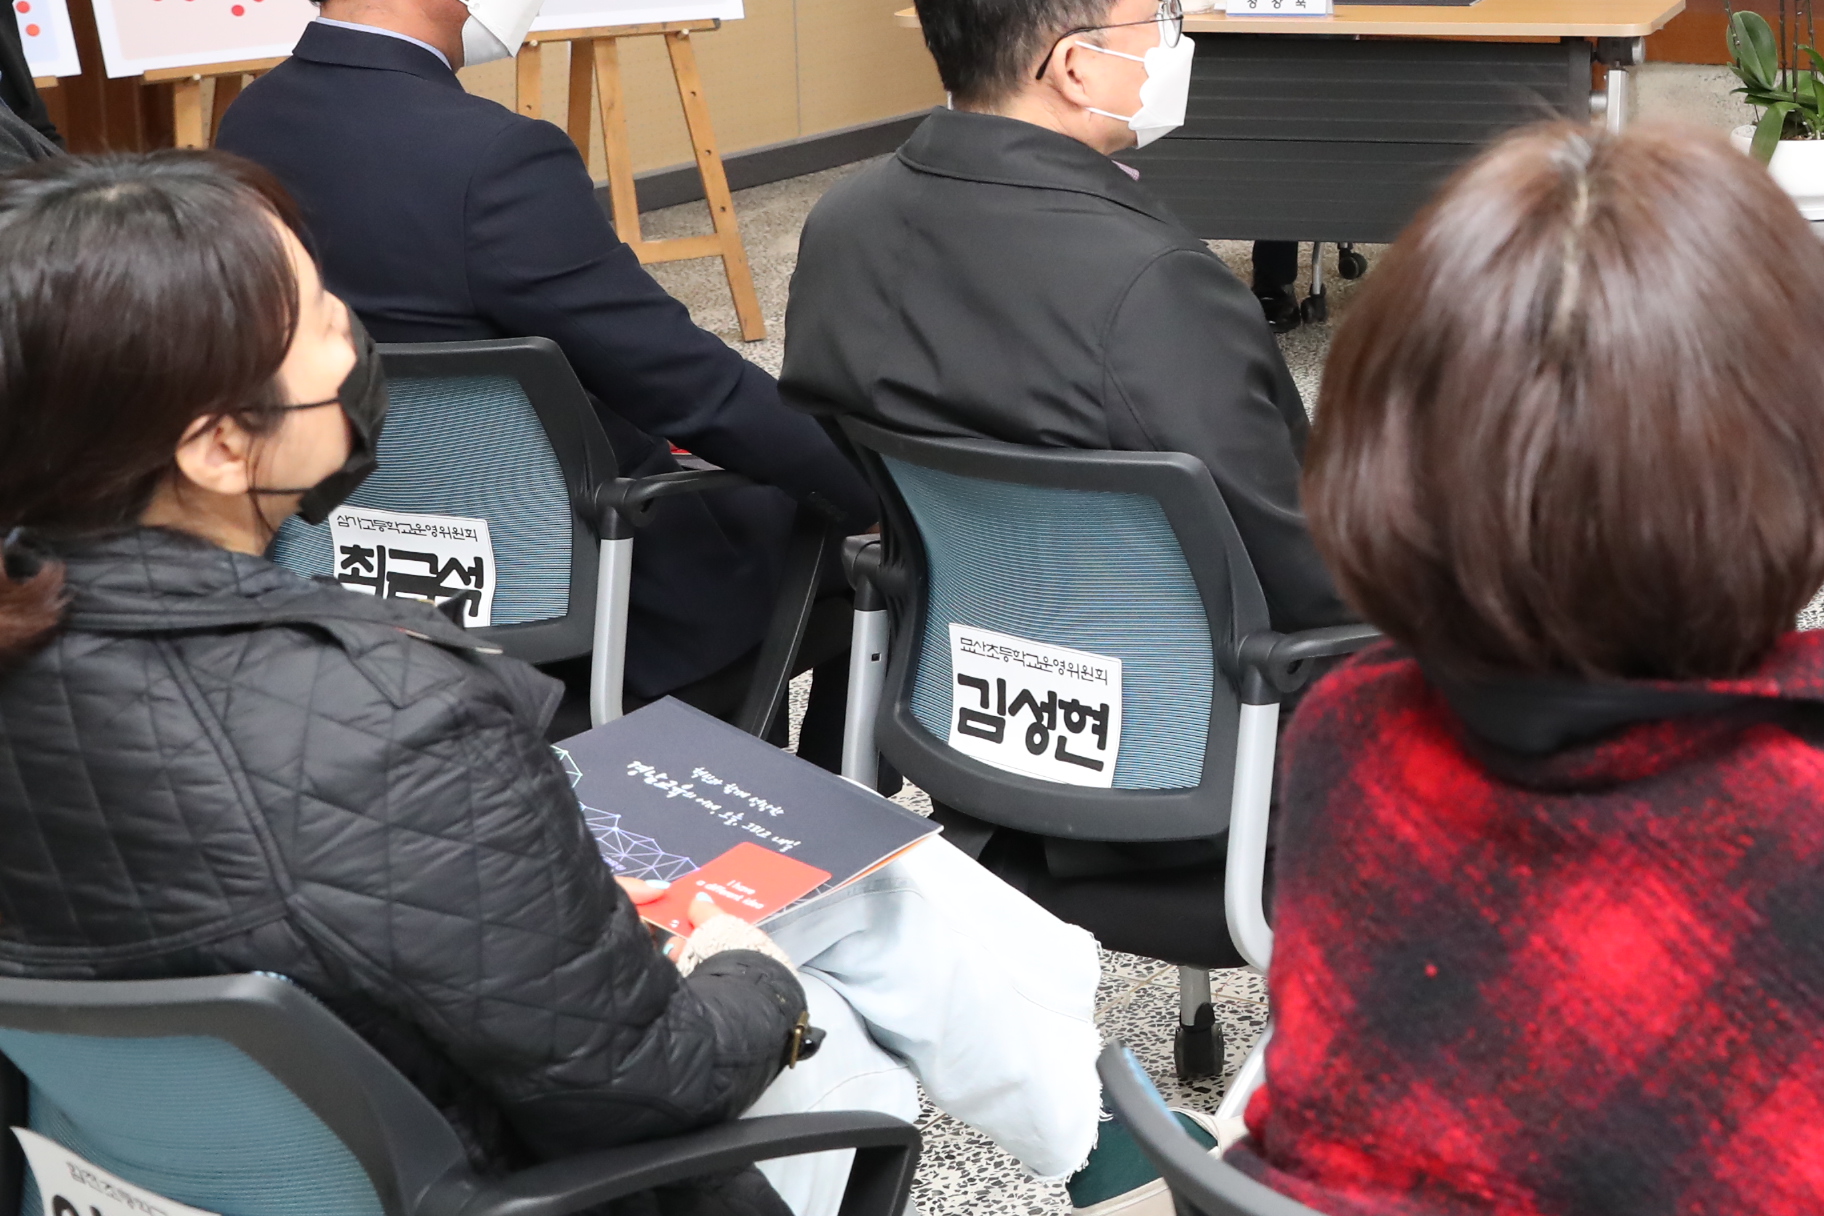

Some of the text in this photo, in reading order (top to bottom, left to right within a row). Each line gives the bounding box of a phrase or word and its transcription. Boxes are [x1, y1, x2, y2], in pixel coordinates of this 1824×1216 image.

[960, 637, 1108, 686] 묘산초등학교운영위원회
[957, 673, 1110, 772] 김성현
[705, 883, 744, 902] different
[742, 896, 765, 910] idea
[734, 882, 756, 895] have
